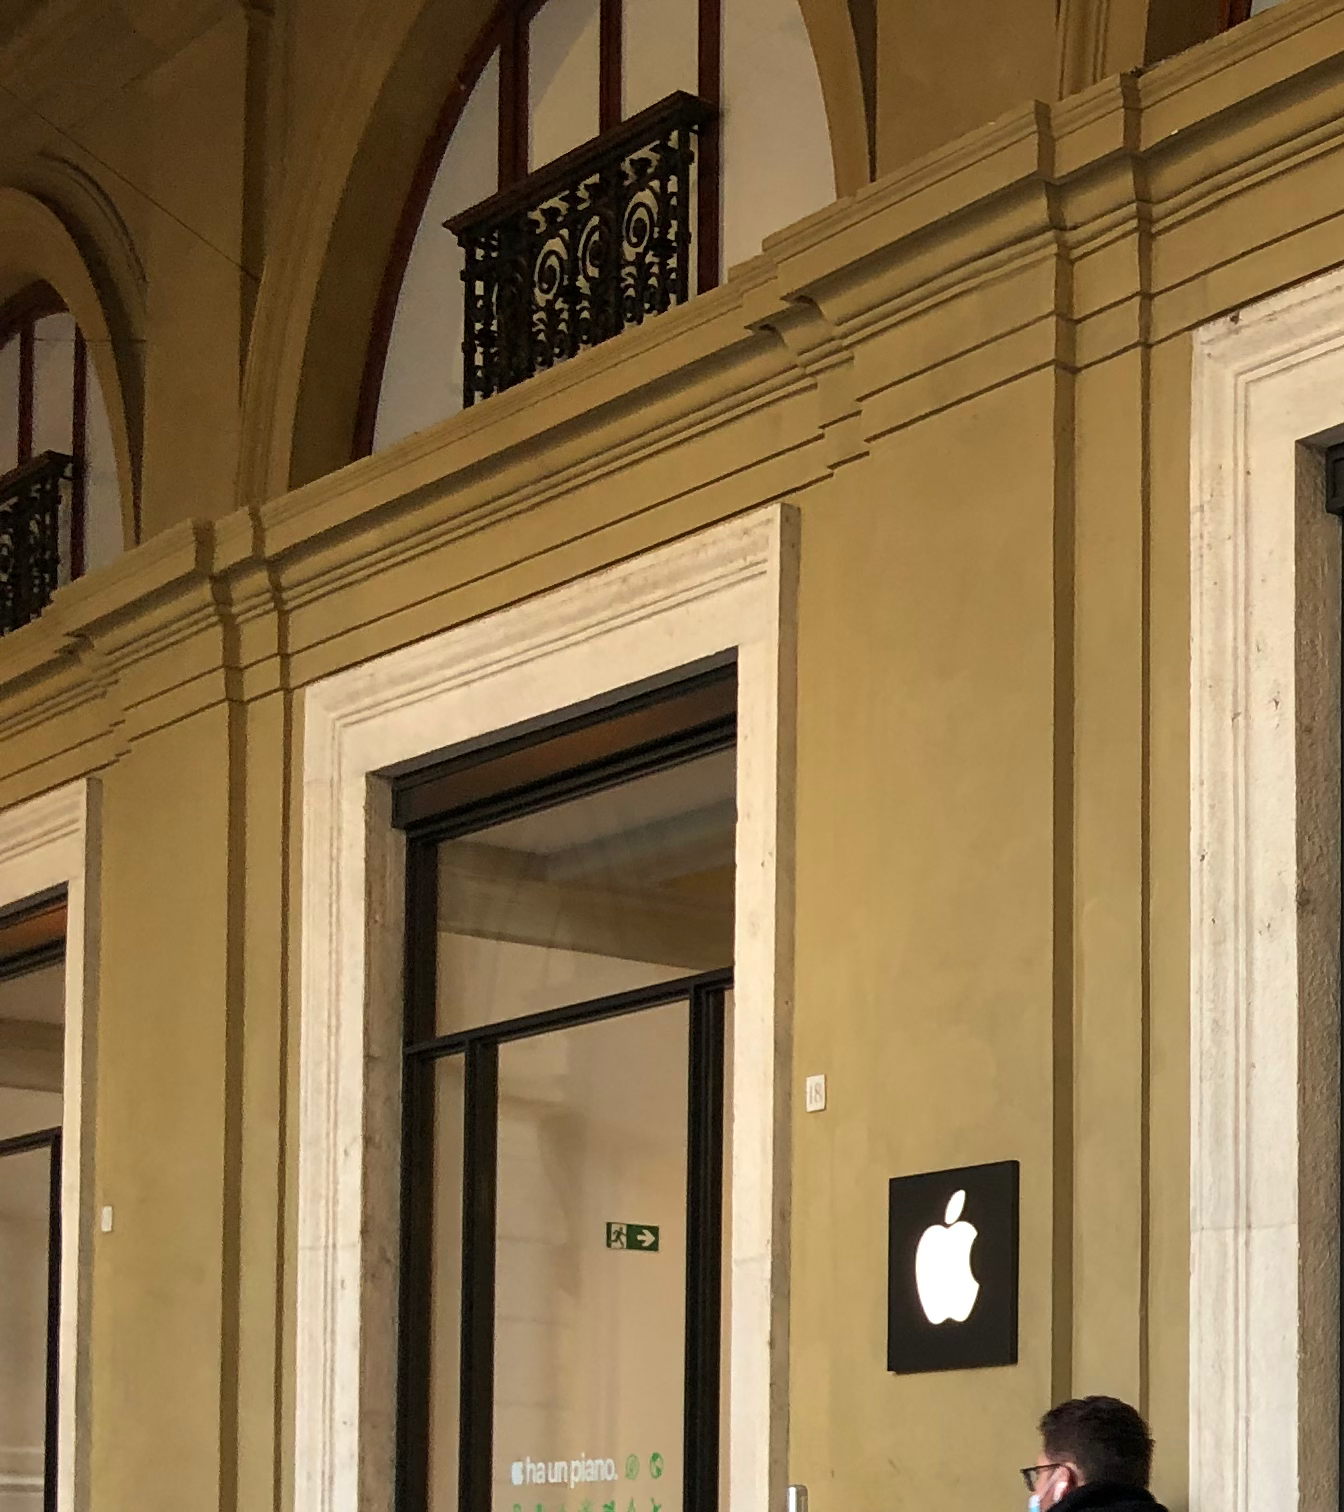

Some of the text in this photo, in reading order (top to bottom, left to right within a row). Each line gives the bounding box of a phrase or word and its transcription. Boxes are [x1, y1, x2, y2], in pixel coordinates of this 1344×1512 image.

[525, 1452, 618, 1489] ha un piano.
